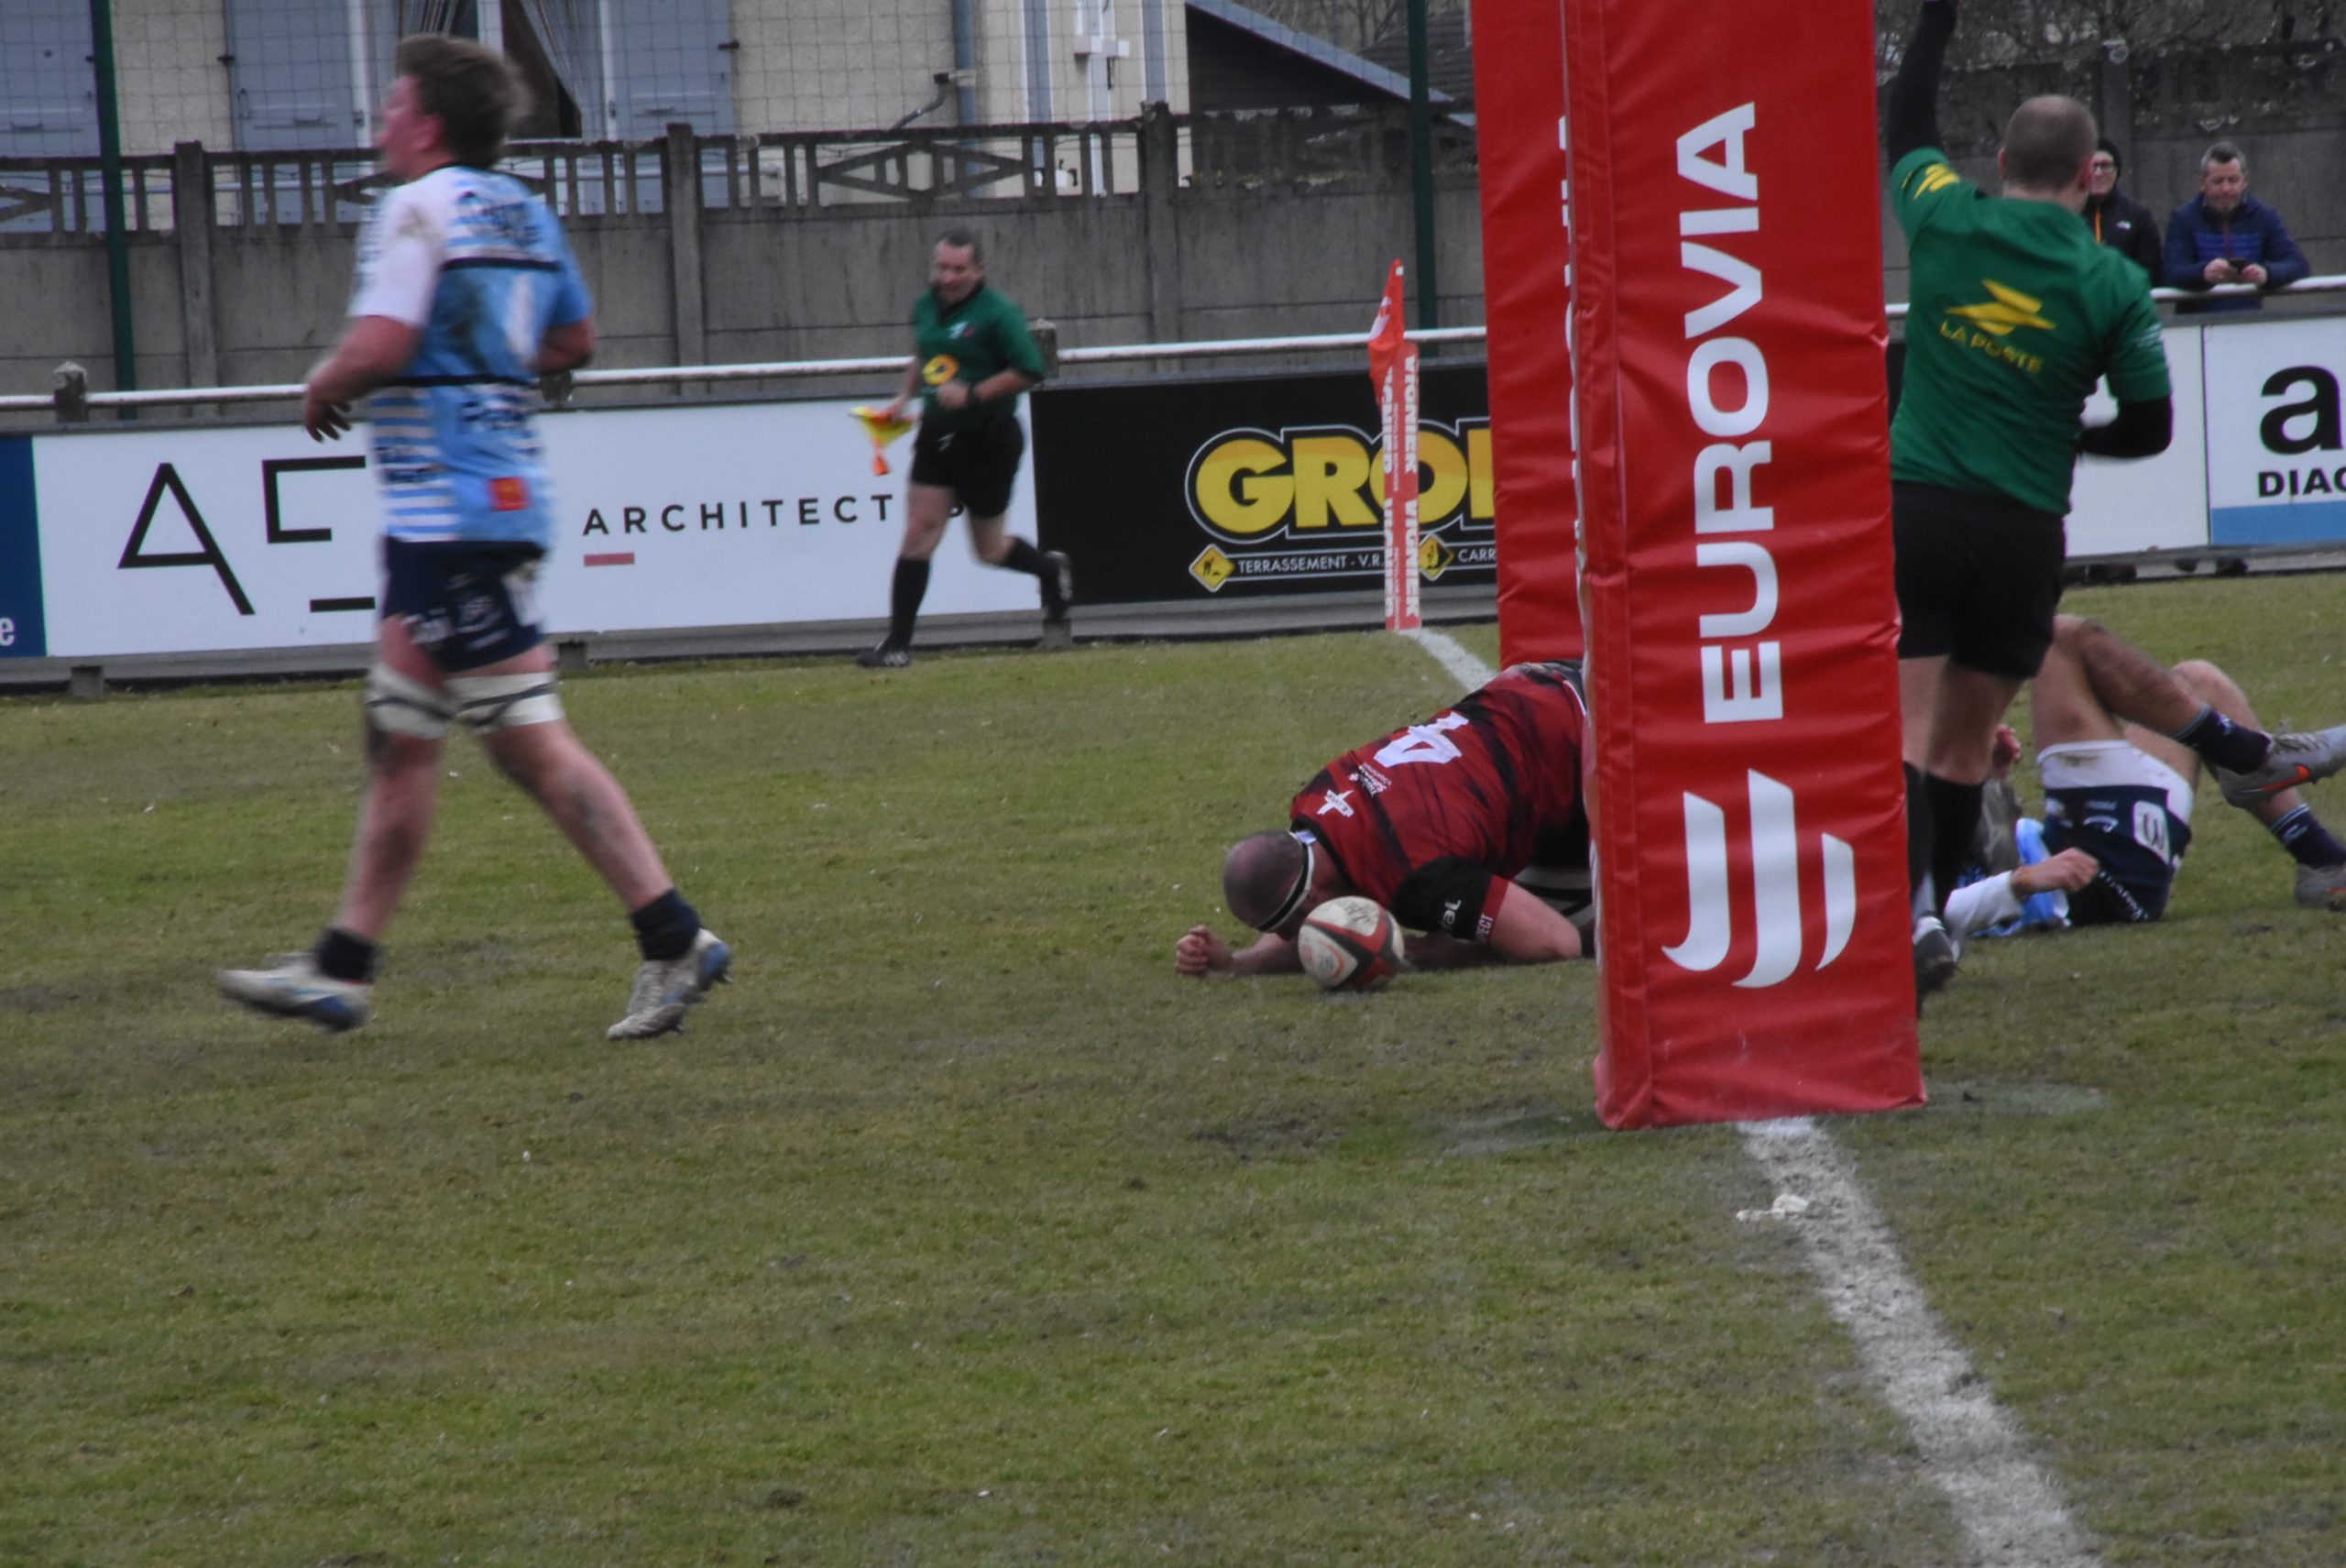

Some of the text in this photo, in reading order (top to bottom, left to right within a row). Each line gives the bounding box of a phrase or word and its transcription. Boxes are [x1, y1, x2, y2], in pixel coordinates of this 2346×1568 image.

[1940, 319, 2043, 373] LA POSTE
[1677, 102, 1783, 723] EUROVIA
[1238, 555, 1347, 574] TERRASSEMENT
[1374, 711, 1469, 768] 4
